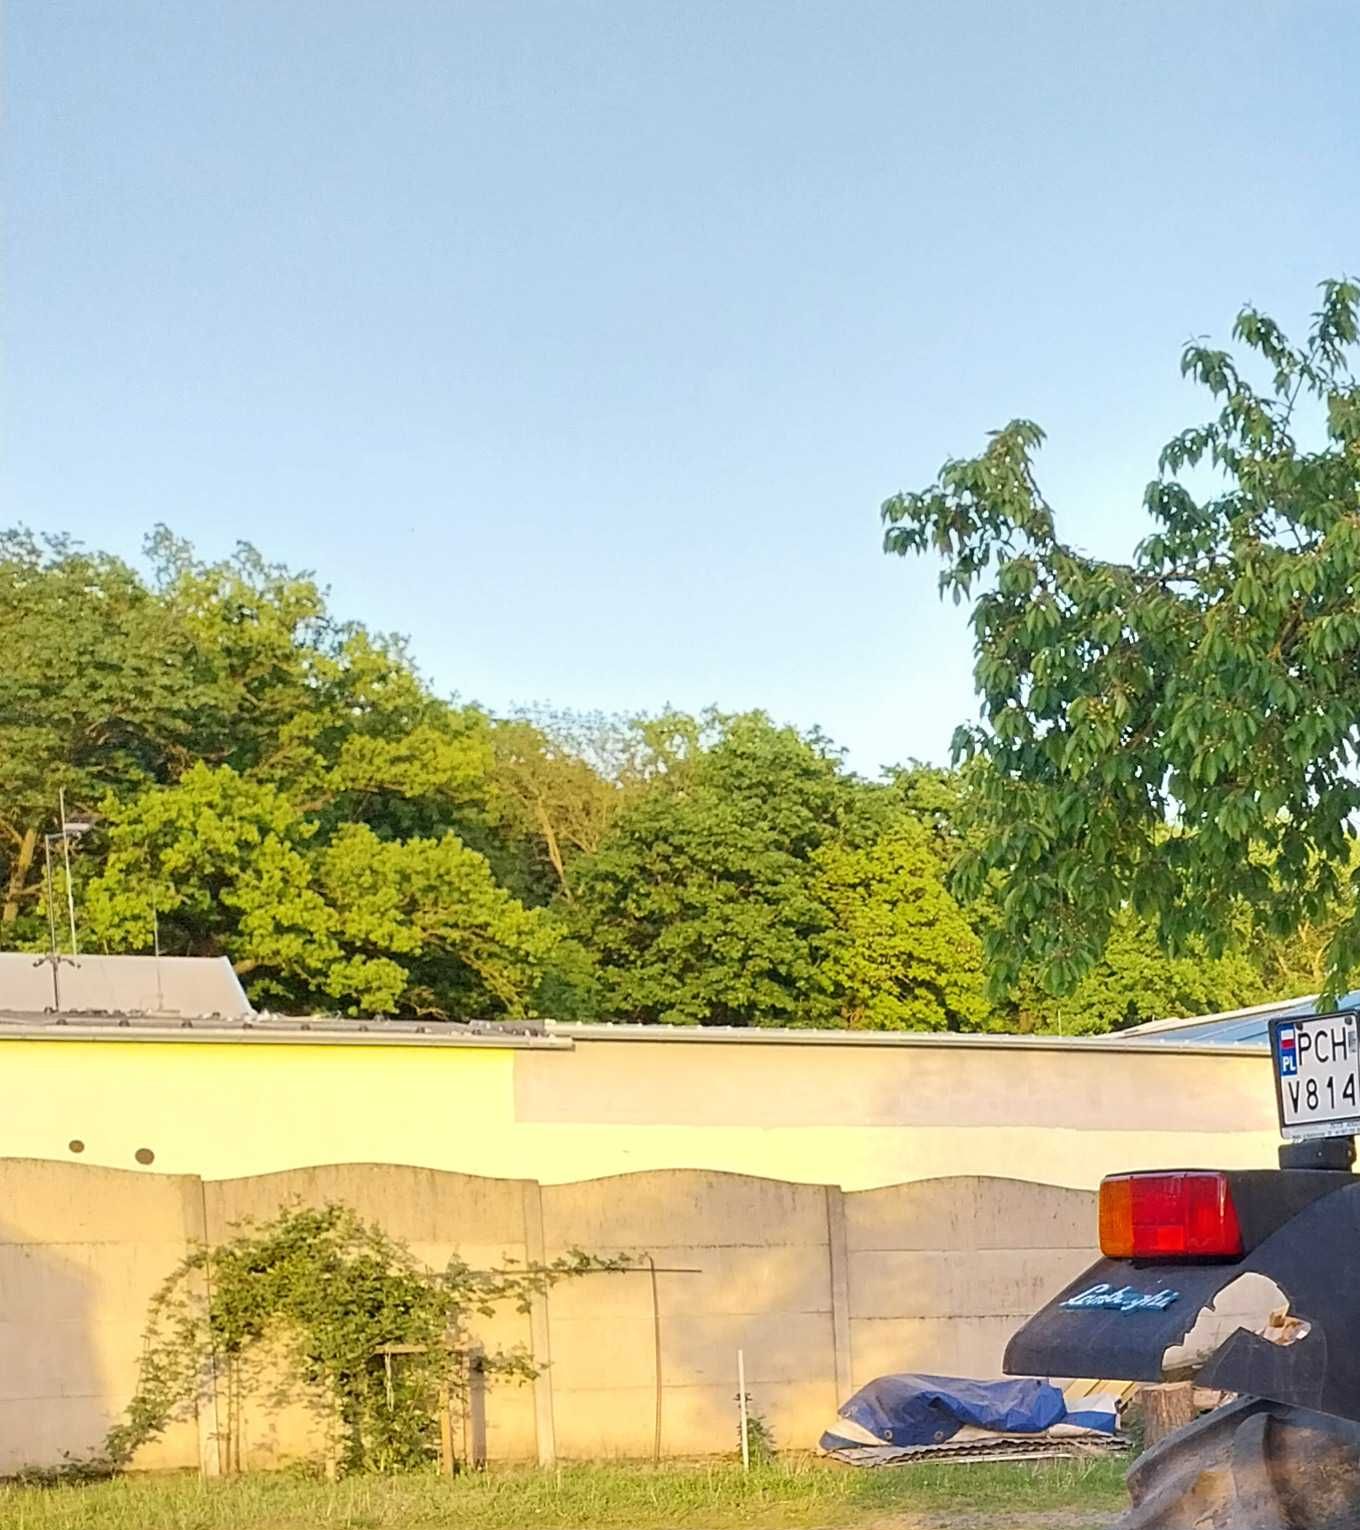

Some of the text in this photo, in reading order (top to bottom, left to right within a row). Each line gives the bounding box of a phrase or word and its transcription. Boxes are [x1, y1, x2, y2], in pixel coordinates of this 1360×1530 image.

[1283, 1056, 1296, 1071] PL
[1298, 1027, 1347, 1065] PCH
[1289, 1073, 1355, 1113] V814
